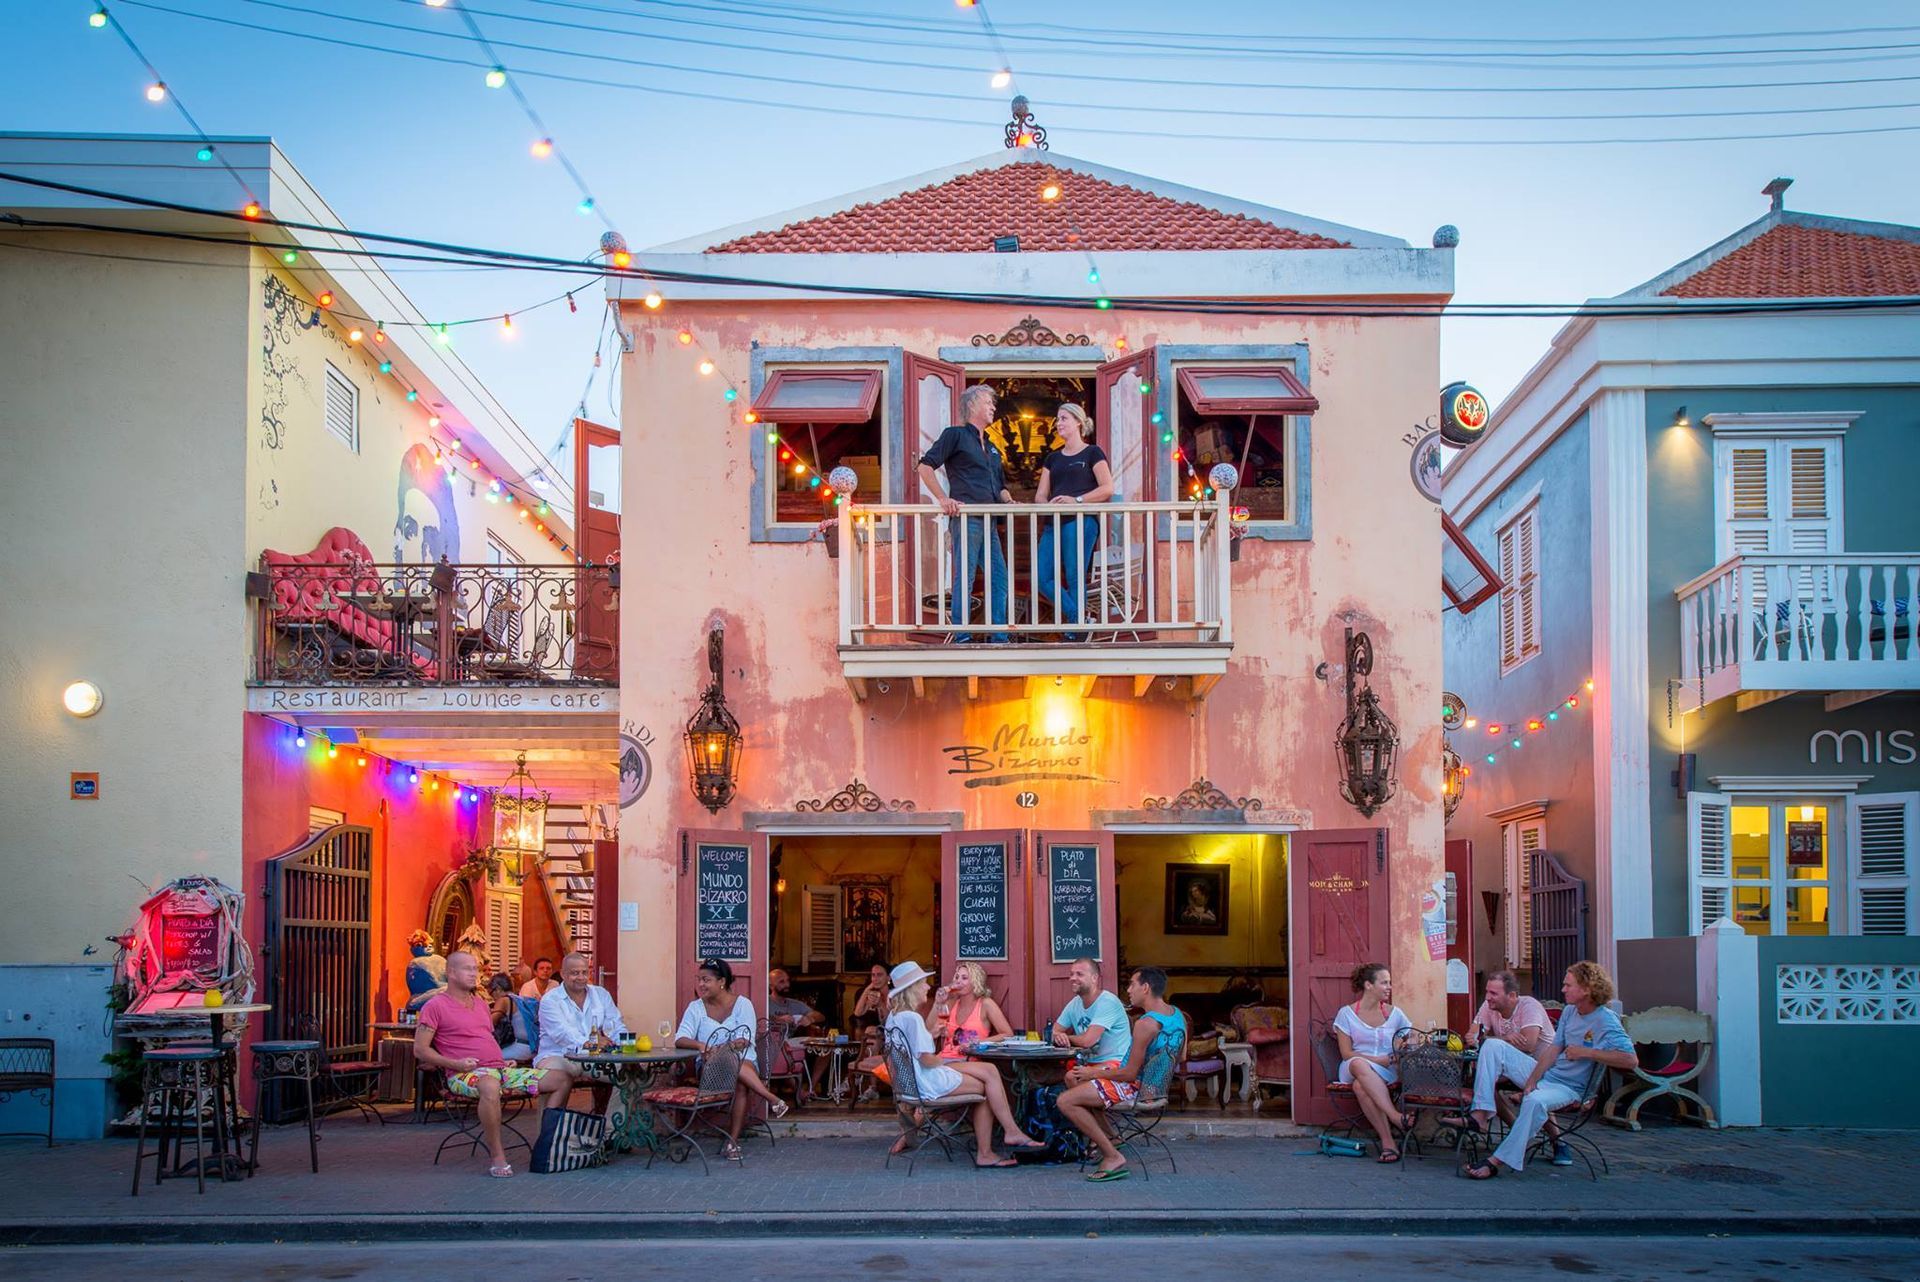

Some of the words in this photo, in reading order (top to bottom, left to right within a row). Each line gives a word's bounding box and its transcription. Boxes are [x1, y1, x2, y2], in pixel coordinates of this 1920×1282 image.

[622, 719, 656, 747] RDI
[993, 723, 1091, 752] Mundo
[942, 746, 1083, 774] Bizarro
[1021, 792, 1034, 807] 12
[701, 850, 746, 862] WELCOME
[963, 847, 983, 857] EVERY
[984, 847, 996, 856] DAY
[1060, 850, 1085, 861] PLATO
[961, 857, 981, 866] HAPPY
[983, 856, 1002, 865] HOUR
[702, 872, 743, 888] MUNDO
[1333, 880, 1370, 888] CHANON
[963, 896, 996, 909] CUBAN
[960, 912, 996, 923] GROOVE
[960, 945, 1002, 956] SATURDAY
